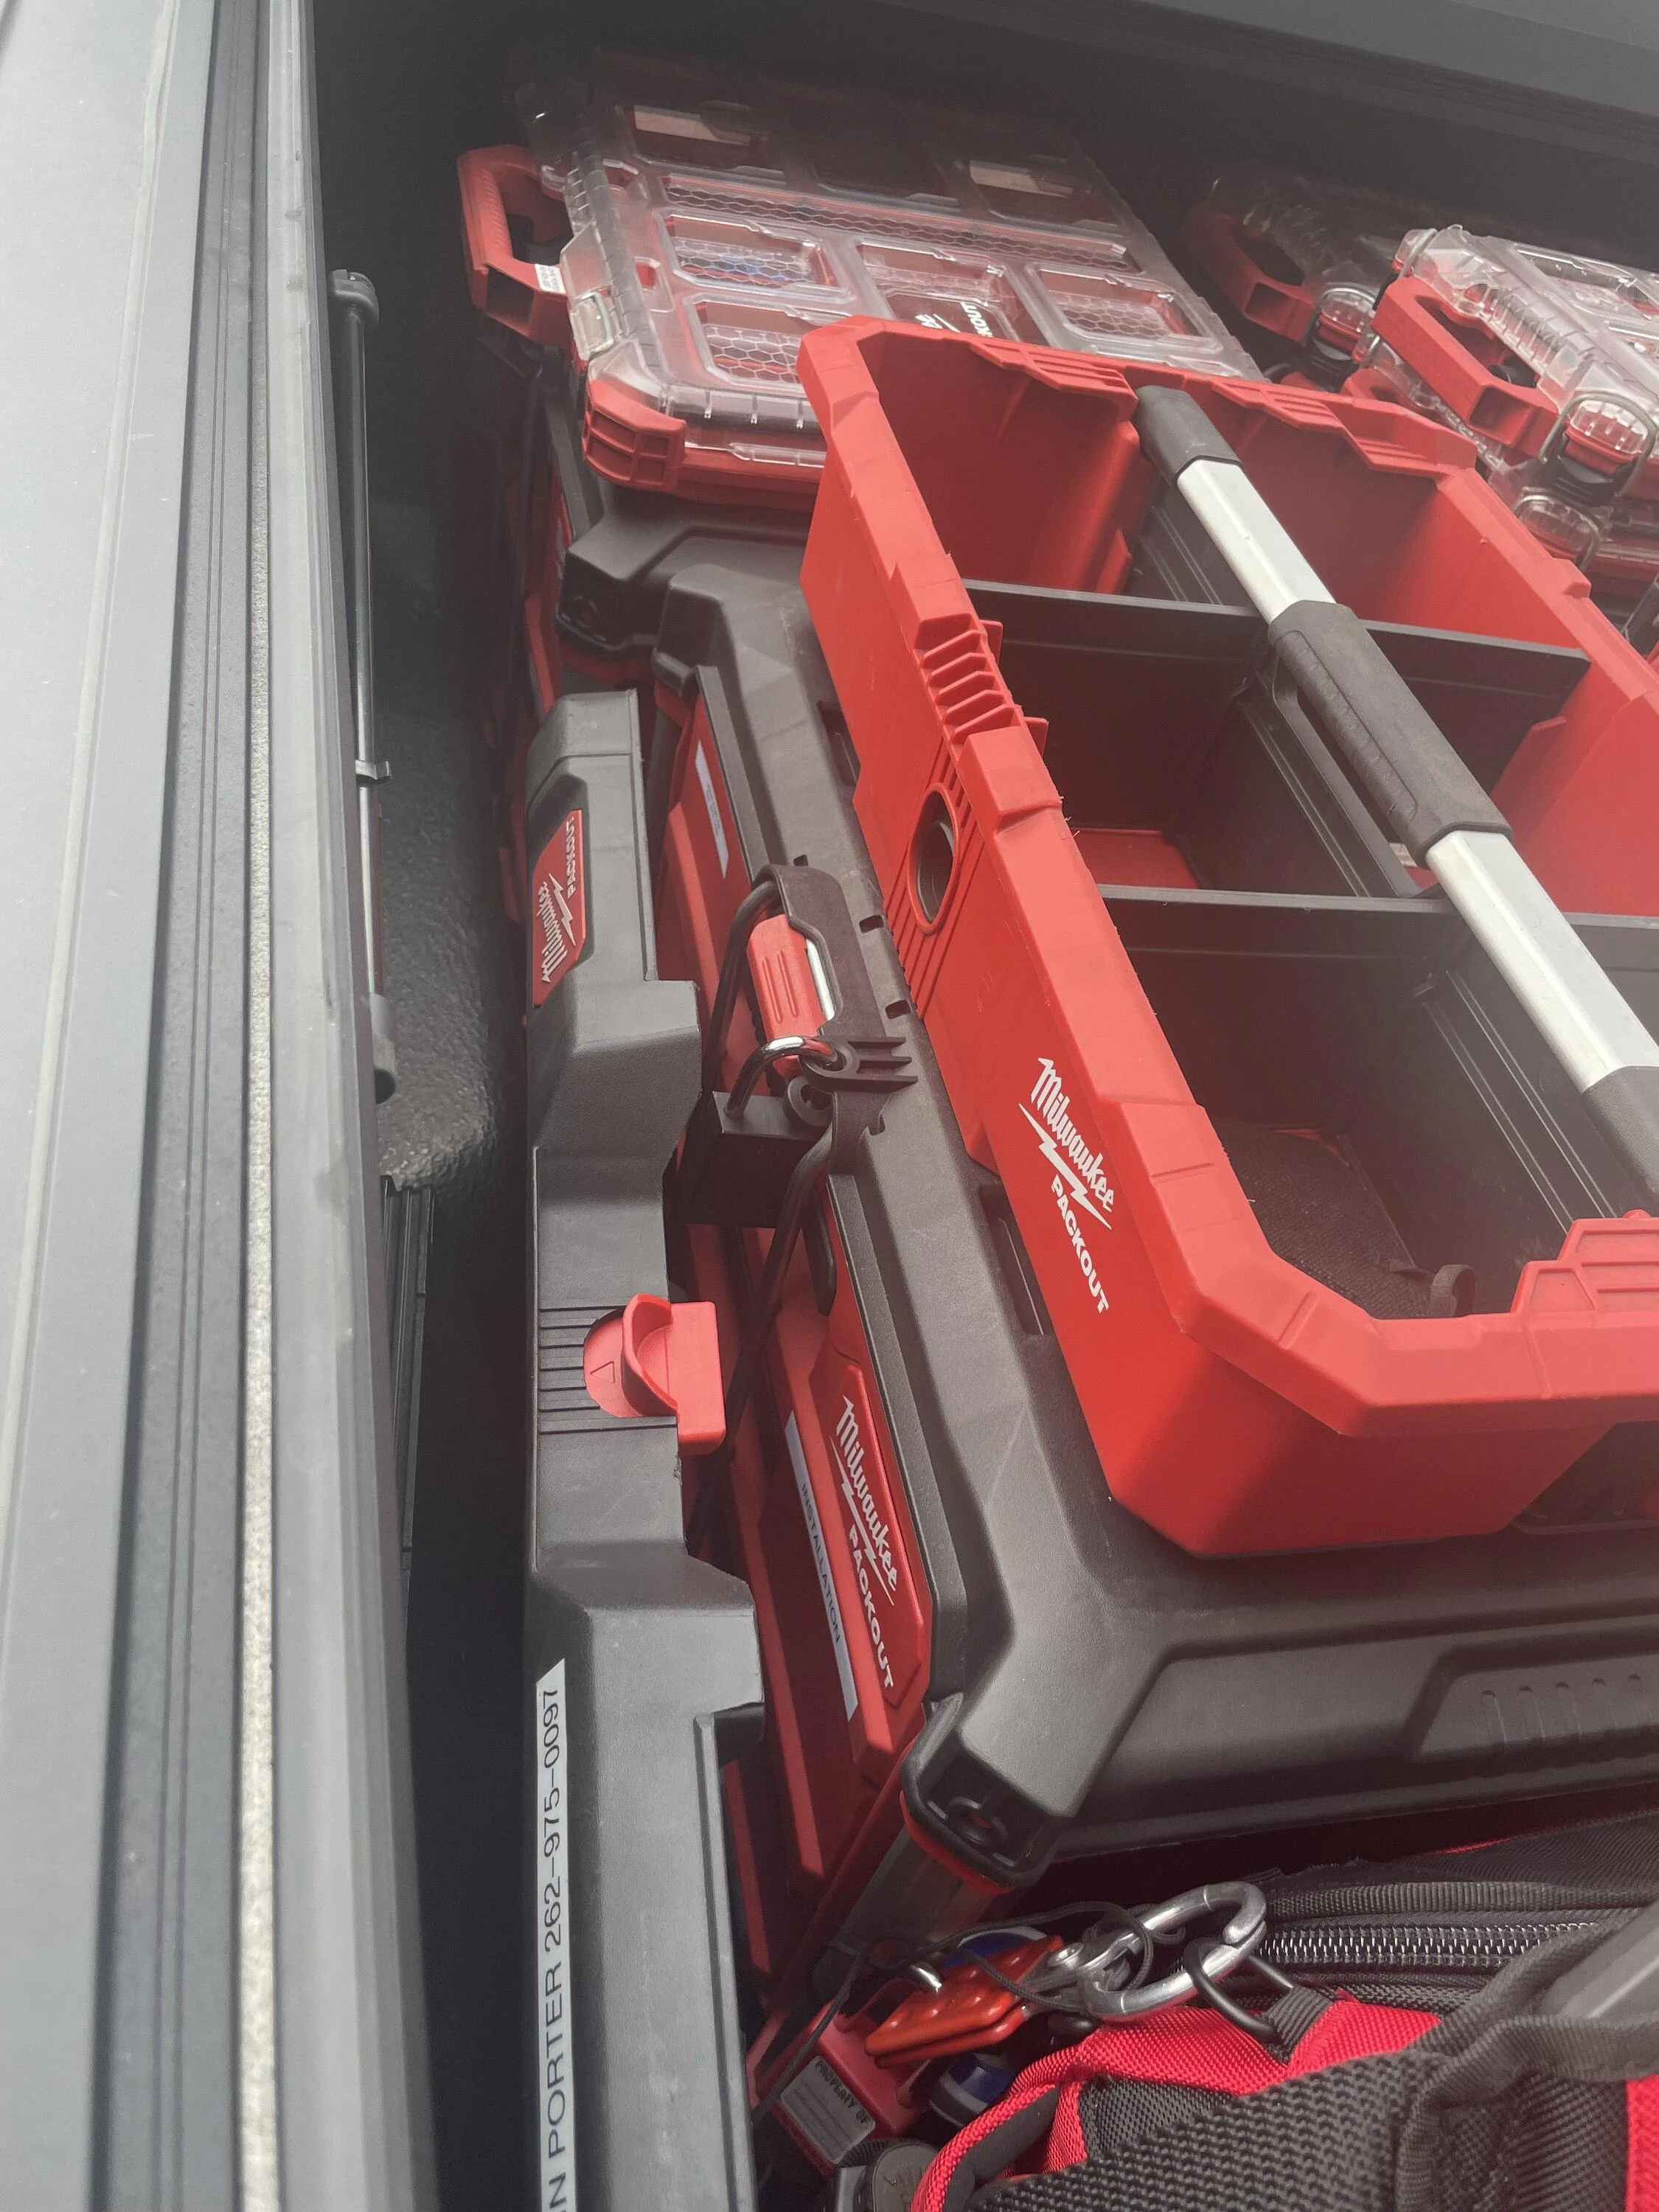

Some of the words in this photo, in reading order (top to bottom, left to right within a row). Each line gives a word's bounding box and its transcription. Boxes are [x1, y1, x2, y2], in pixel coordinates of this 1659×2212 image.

[960, 302, 993, 337] KOUT
[566, 816, 577, 900] PACKOUT
[536, 881, 568, 983] Milwaukee
[1031, 1057, 1114, 1212] Milwaukee
[1051, 1174, 1109, 1313] PACKOUT
[801, 1482, 841, 1644] INSTALLATION
[836, 1395, 897, 1591] Milwaukee
[849, 1524, 894, 1688] PACKOUT
[543, 1690, 561, 1953] 262-975-0097
[545, 1961, 566, 2159] PORTER
[815, 2060, 856, 2109] PROPERTY
[549, 2172, 567, 2212] N
